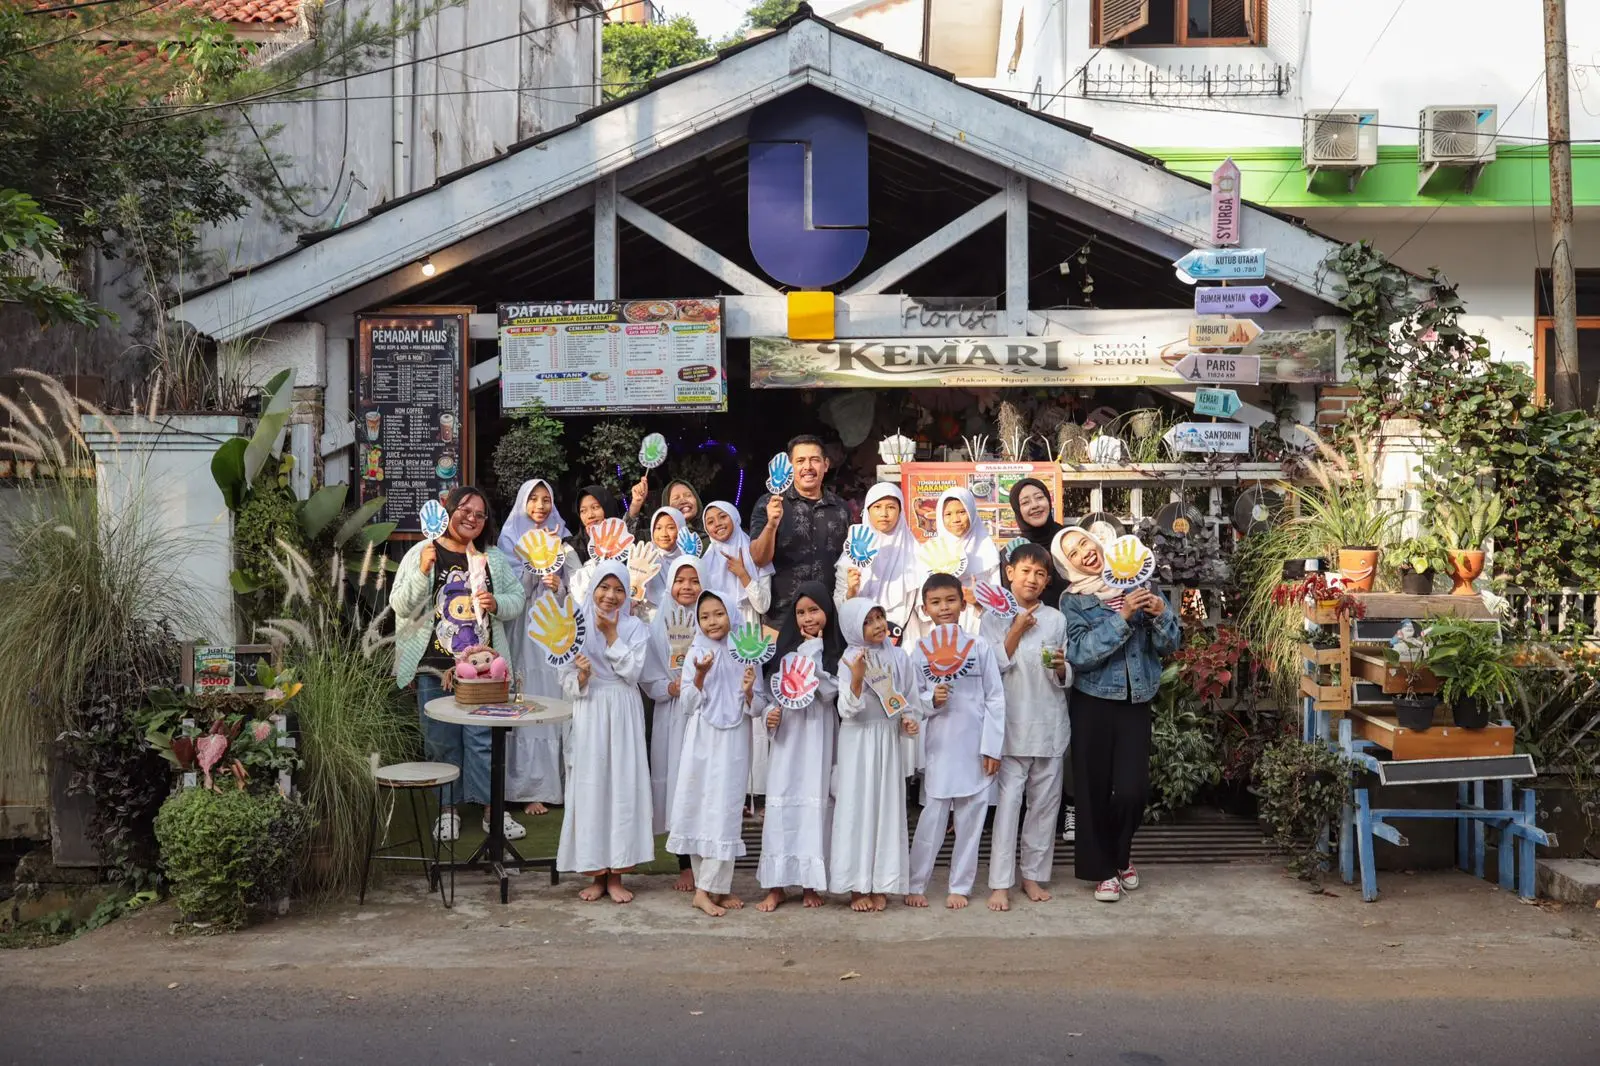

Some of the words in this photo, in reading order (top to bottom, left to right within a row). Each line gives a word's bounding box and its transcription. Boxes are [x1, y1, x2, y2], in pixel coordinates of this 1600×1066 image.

[1216, 198, 1233, 240] SYURGA
[1216, 256, 1236, 265] KUTUB
[1238, 256, 1258, 264] UTARA
[1200, 294, 1221, 304] RUMAH
[1222, 293, 1246, 302] MANTAN
[506, 304, 562, 318] DAFTAR
[567, 304, 609, 315] MENU
[902, 304, 993, 329] Florist
[1196, 325, 1228, 334] TIMBUKTU
[372, 330, 419, 343] PEMADAM
[422, 330, 447, 343] HAUS
[817, 340, 1068, 374] KEMARI
[1206, 360, 1236, 371] PARIS
[1199, 393, 1219, 405] KEMARI
[1204, 430, 1241, 440] SANTORINI
[1104, 570, 1127, 584] IMAH
[1128, 557, 1152, 585] SEURI
[548, 652, 570, 666] IMAH
[570, 608, 586, 655] SEURI
[923, 664, 941, 683] Imah
[944, 658, 976, 682] SEURI
[202, 677, 230, 686] 5000
